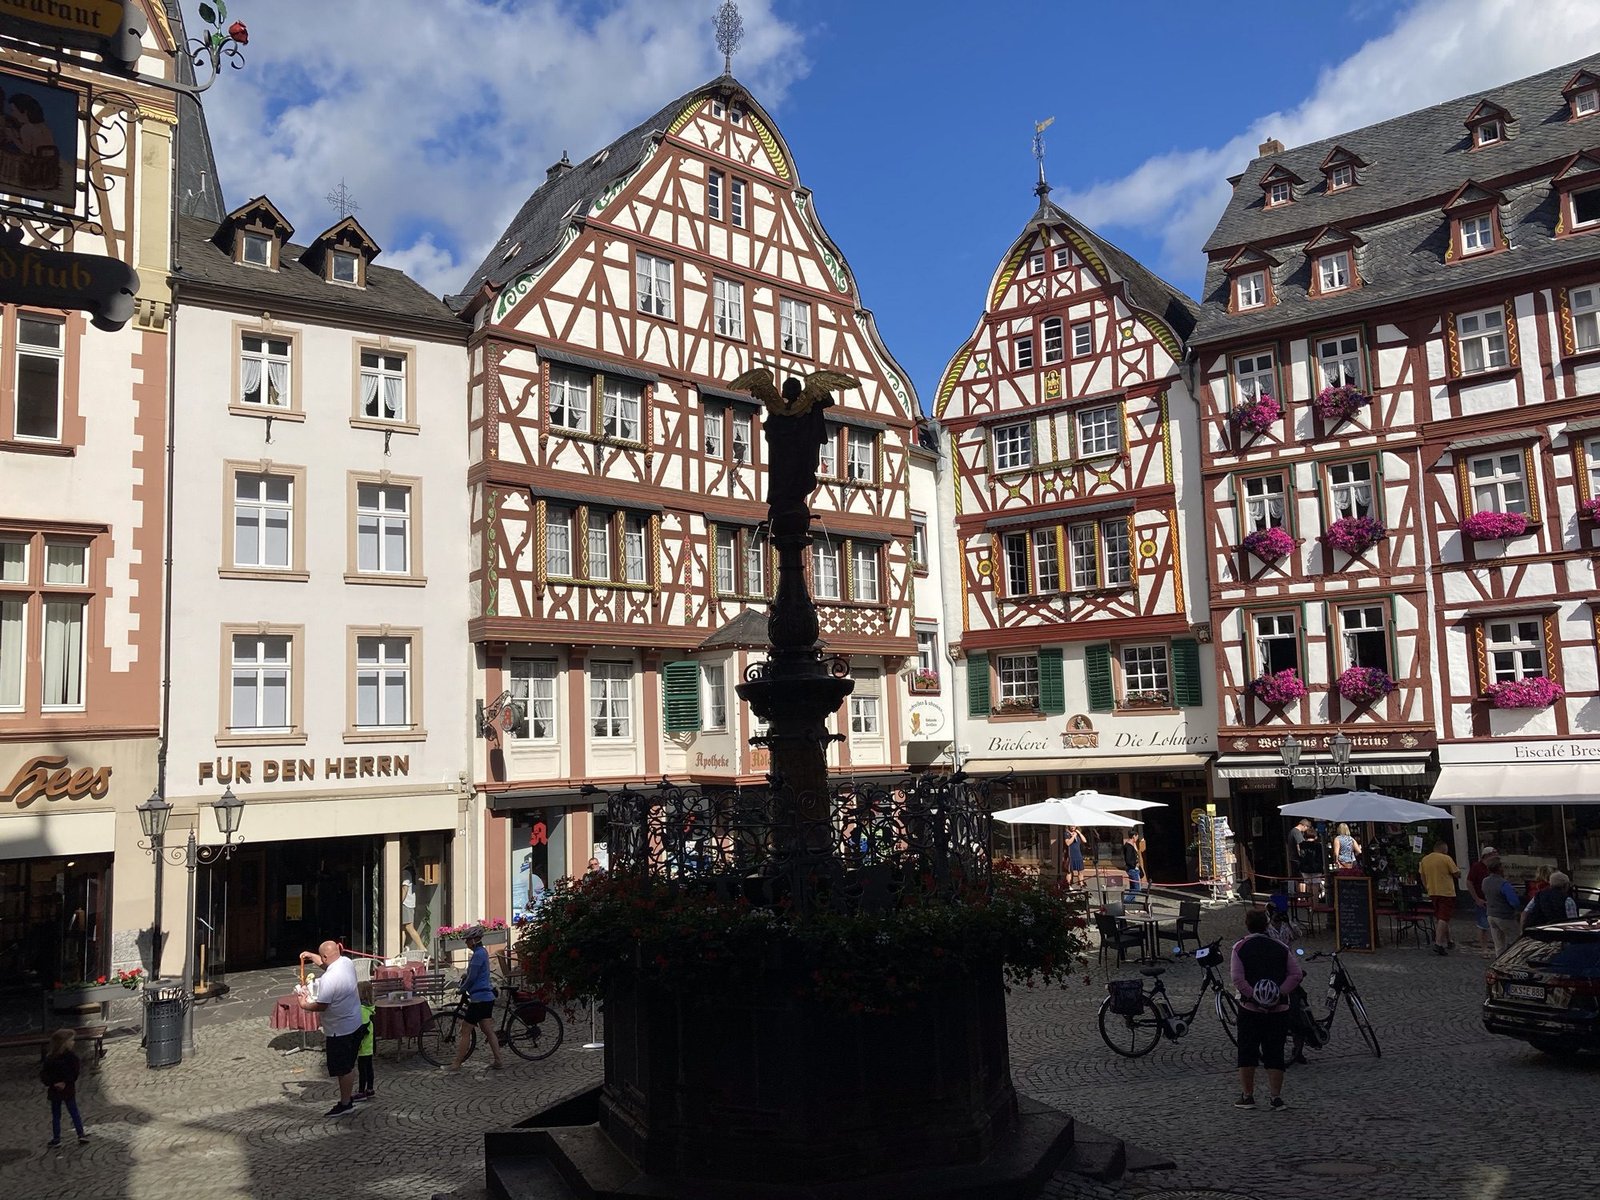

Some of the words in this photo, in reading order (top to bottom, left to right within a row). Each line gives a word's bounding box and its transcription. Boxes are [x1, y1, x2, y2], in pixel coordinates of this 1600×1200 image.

[987, 730, 1049, 752] Bäckerei
[1114, 731, 1143, 748] Die
[1257, 737, 1318, 749] Weiaus
[1514, 744, 1565, 758] Eiscafé
[694, 751, 729, 770] Apotheke
[199, 756, 252, 786] FÜR
[262, 758, 315, 783] DEN
[324, 754, 410, 780] HERRN
[1320, 764, 1363, 778] Weigut
